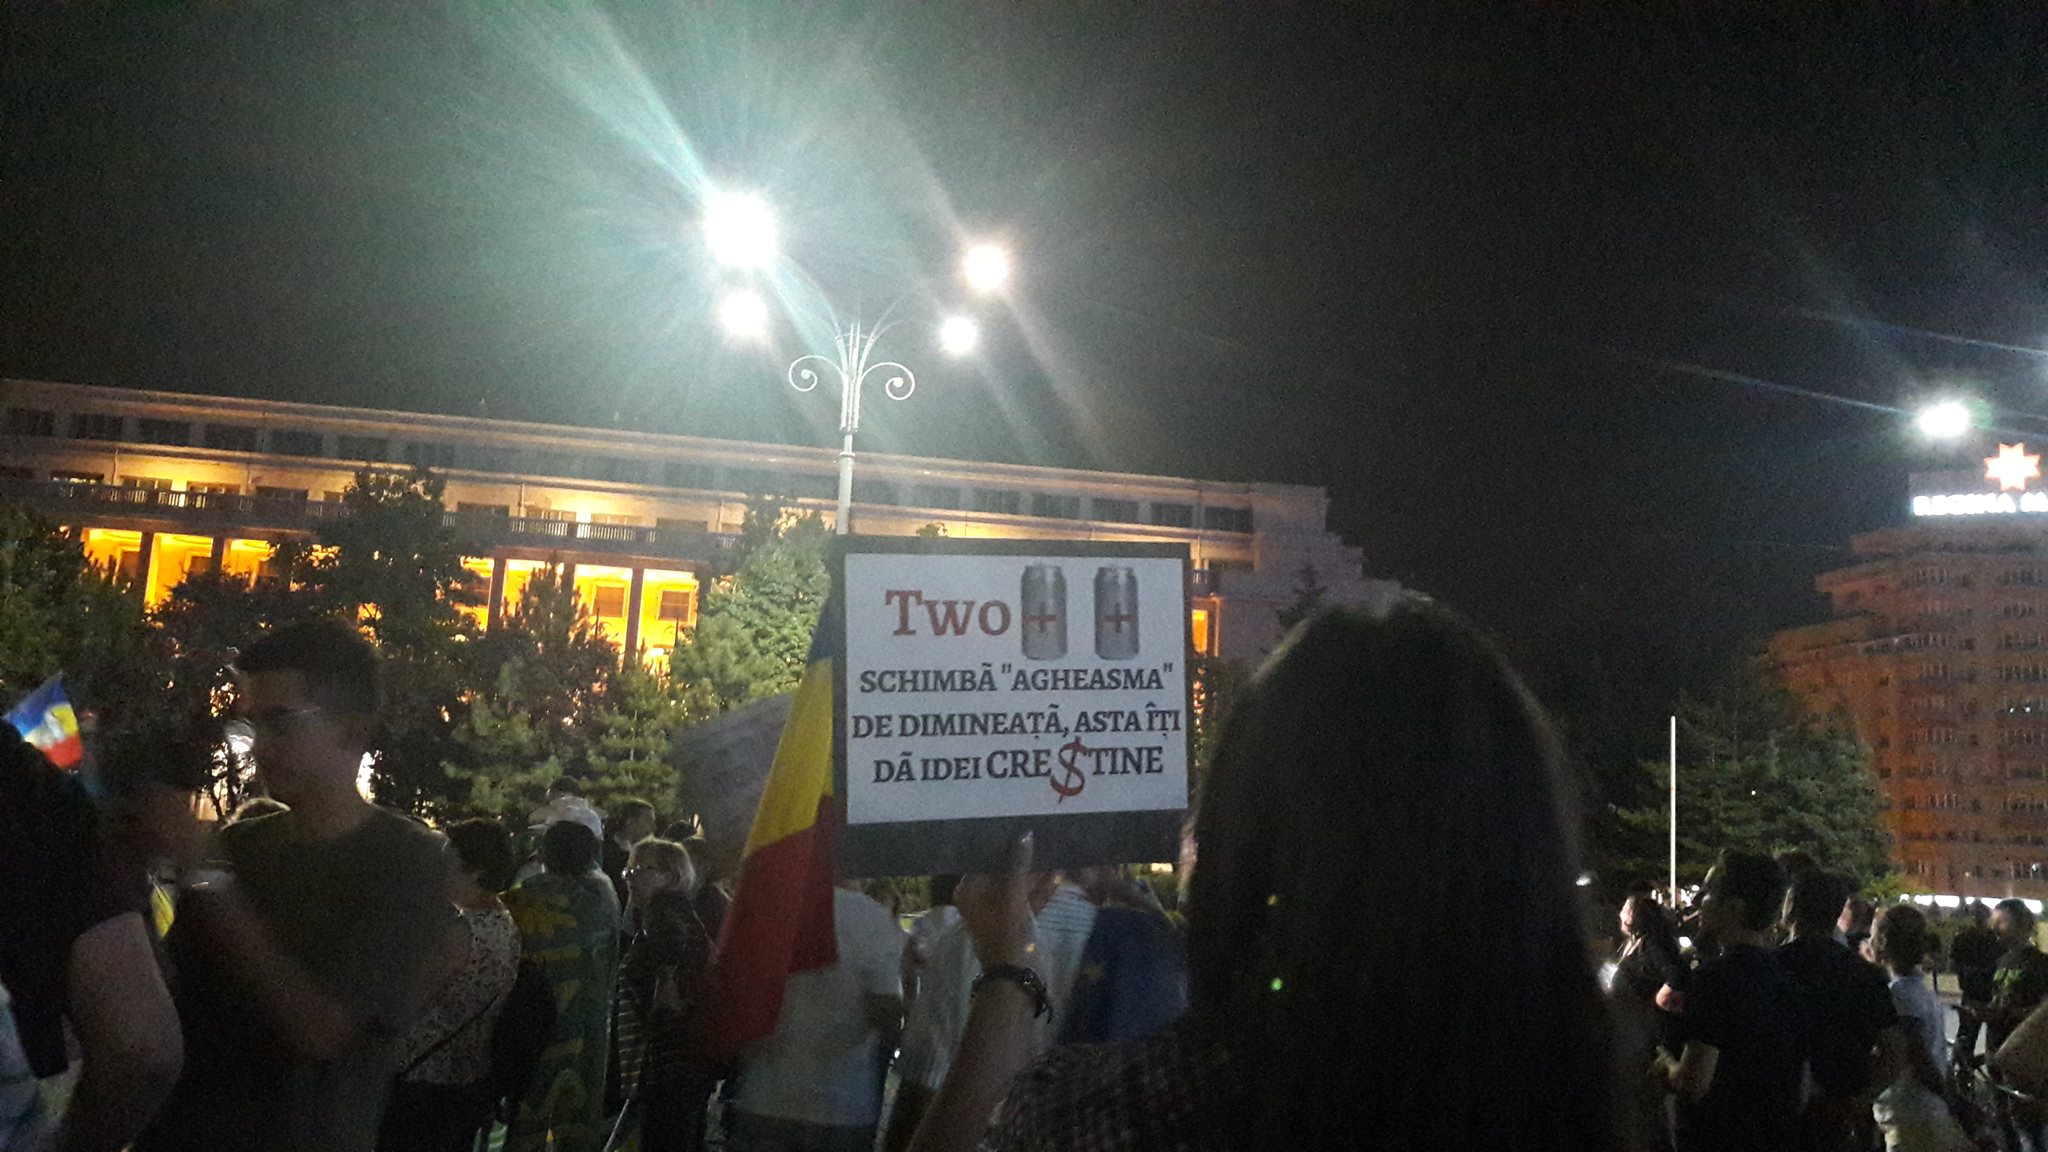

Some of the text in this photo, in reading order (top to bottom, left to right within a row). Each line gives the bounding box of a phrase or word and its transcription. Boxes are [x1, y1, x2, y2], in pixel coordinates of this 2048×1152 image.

[852, 714, 893, 738] DE
[1074, 711, 1141, 732] ASTA
[920, 757, 982, 781] IDEI
